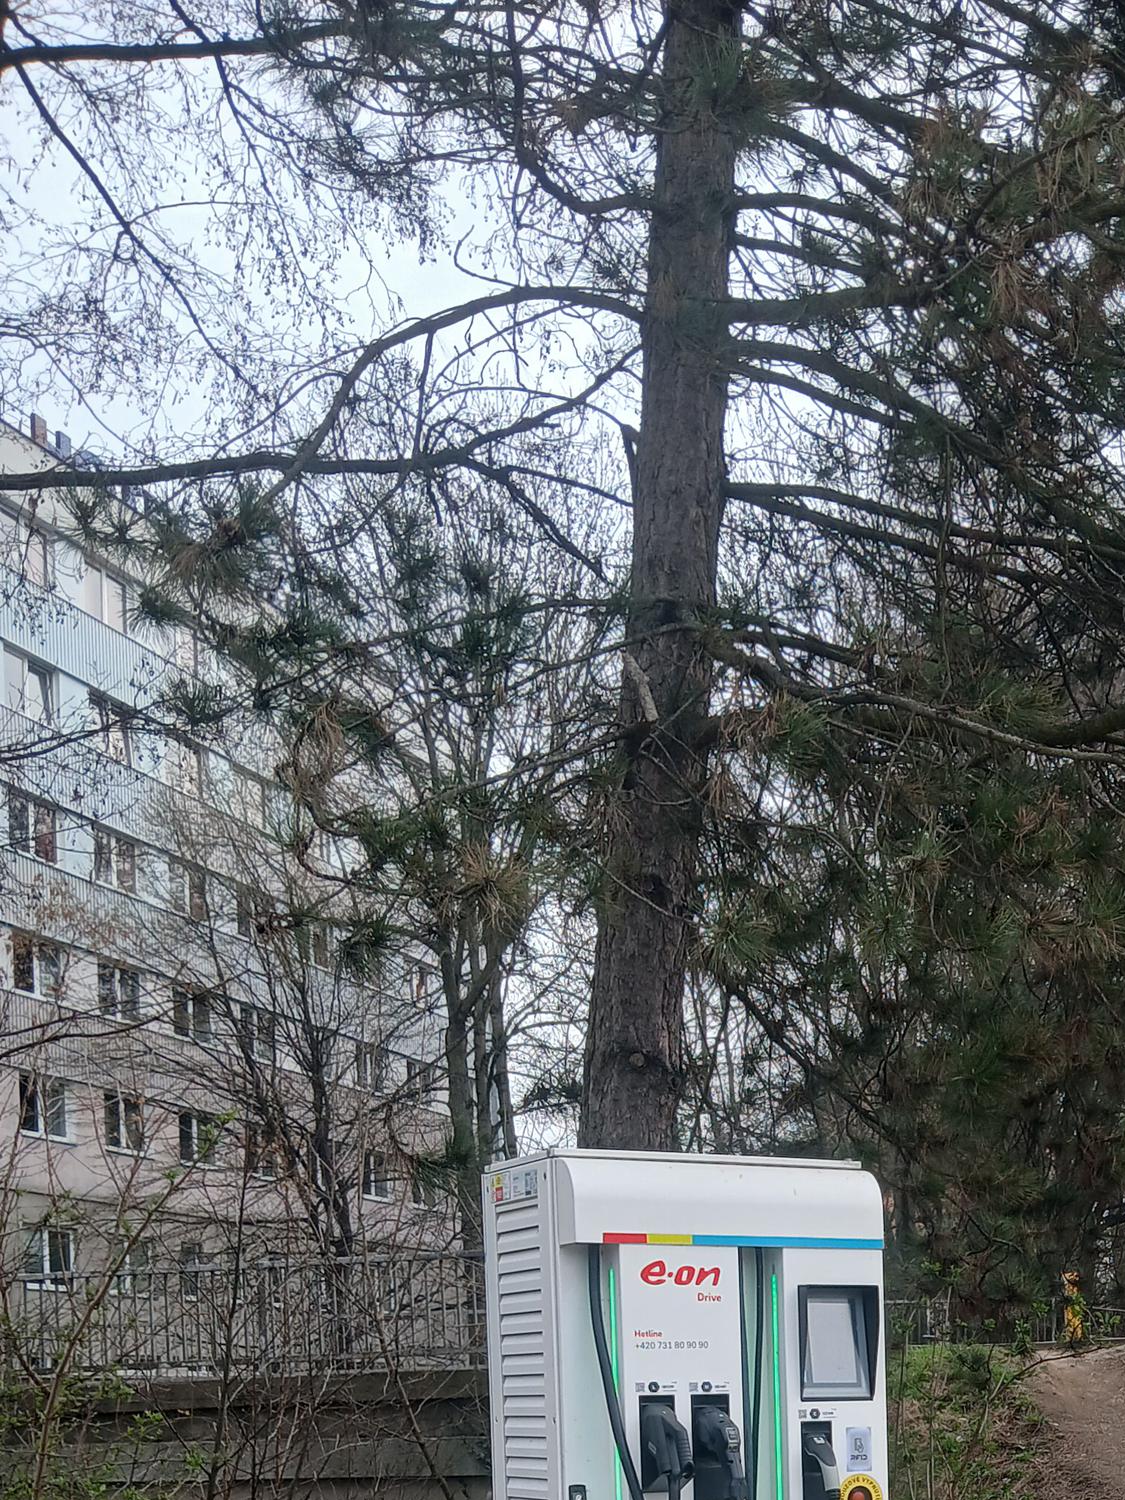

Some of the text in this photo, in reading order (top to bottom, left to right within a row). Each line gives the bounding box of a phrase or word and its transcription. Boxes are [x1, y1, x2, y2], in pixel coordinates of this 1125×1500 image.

[697, 1291, 722, 1302] Drive
[634, 1330, 663, 1338] Hotline
[635, 1340, 709, 1350] +420 731 80 90 90
